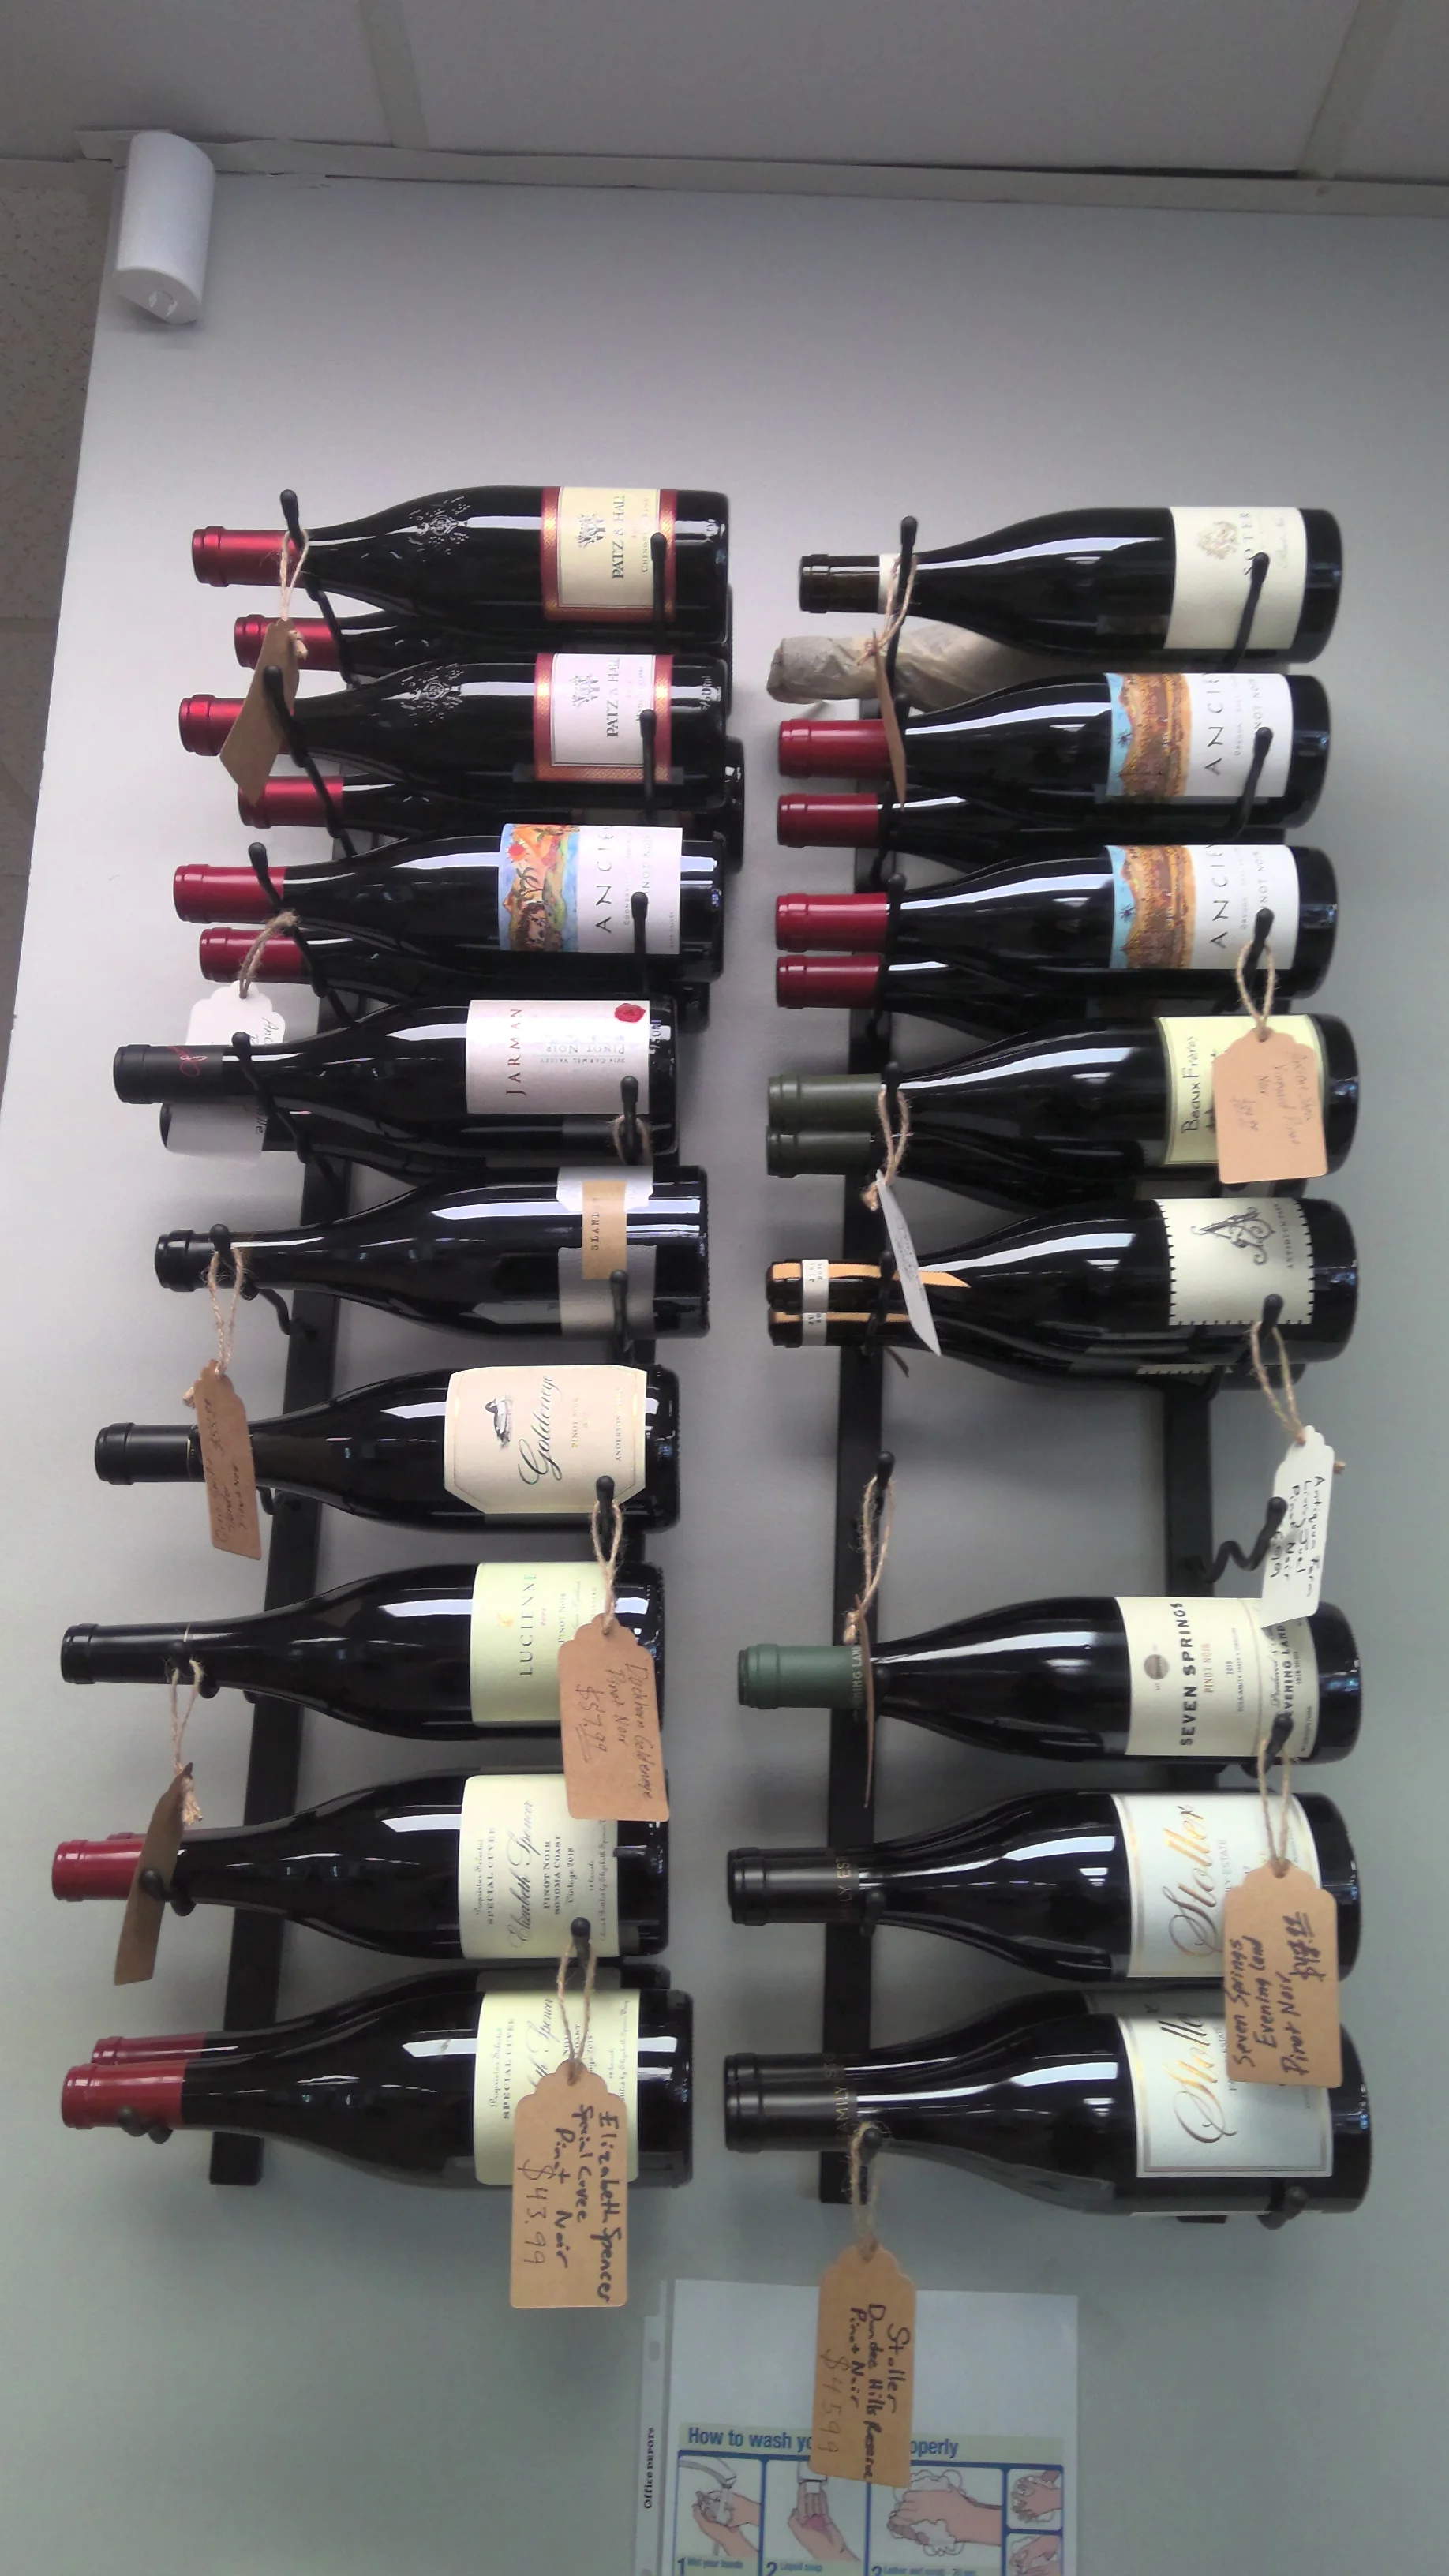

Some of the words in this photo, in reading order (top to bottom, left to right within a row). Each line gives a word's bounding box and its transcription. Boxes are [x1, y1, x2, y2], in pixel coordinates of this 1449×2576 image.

[614, 527, 623, 536] &
[612, 540, 624, 579] PATZ
[606, 699, 619, 737] PATZ
[505, 1009, 526, 1095] JARMAN
[546, 1045, 577, 1054] NOIR
[586, 1044, 625, 1054] PINOT
[1180, 1082, 1201, 1133] Beaux
[517, 1376, 563, 1485] Goldeneye
[519, 1574, 537, 1676] LUCIENNE
[1170, 1602, 1196, 1676] SPRINGS
[1201, 1642, 1212, 1663] NOIR
[605, 1668, 626, 1706] Pinot
[624, 1663, 649, 1729] Duckhorn
[1203, 1668, 1214, 1694] PINOT
[1179, 1686, 1197, 1746] SEVEN
[507, 1800, 541, 1866] Spencer
[1218, 1839, 1229, 1874] ESTATE
[507, 1868, 534, 1947] Elizabeth
[1162, 1804, 1222, 1958] Stoller
[1225, 1939, 1251, 2007] Springs
[1275, 1971, 1301, 2016] Noir
[526, 1998, 560, 2053] Spencer
[1250, 1977, 1277, 2048] Evening
[1230, 2014, 1256, 2068] Seven
[1280, 2021, 1309, 2076] Pinot
[1159, 2014, 1239, 2144] Stolle
[553, 2128, 575, 2184] Pinot
[598, 2111, 621, 2223] Elizabeth
[590, 2227, 622, 2303] Spencer
[850, 2307, 867, 2355] Pinot
[867, 2303, 886, 2369] Dundee
[850, 2360, 866, 2409] Noir
[886, 2323, 911, 2414] Stoller
[688, 2428, 724, 2445] How
[728, 2430, 743, 2447] to
[749, 2432, 792, 2448] wash
[643, 2472, 653, 2509] Office
